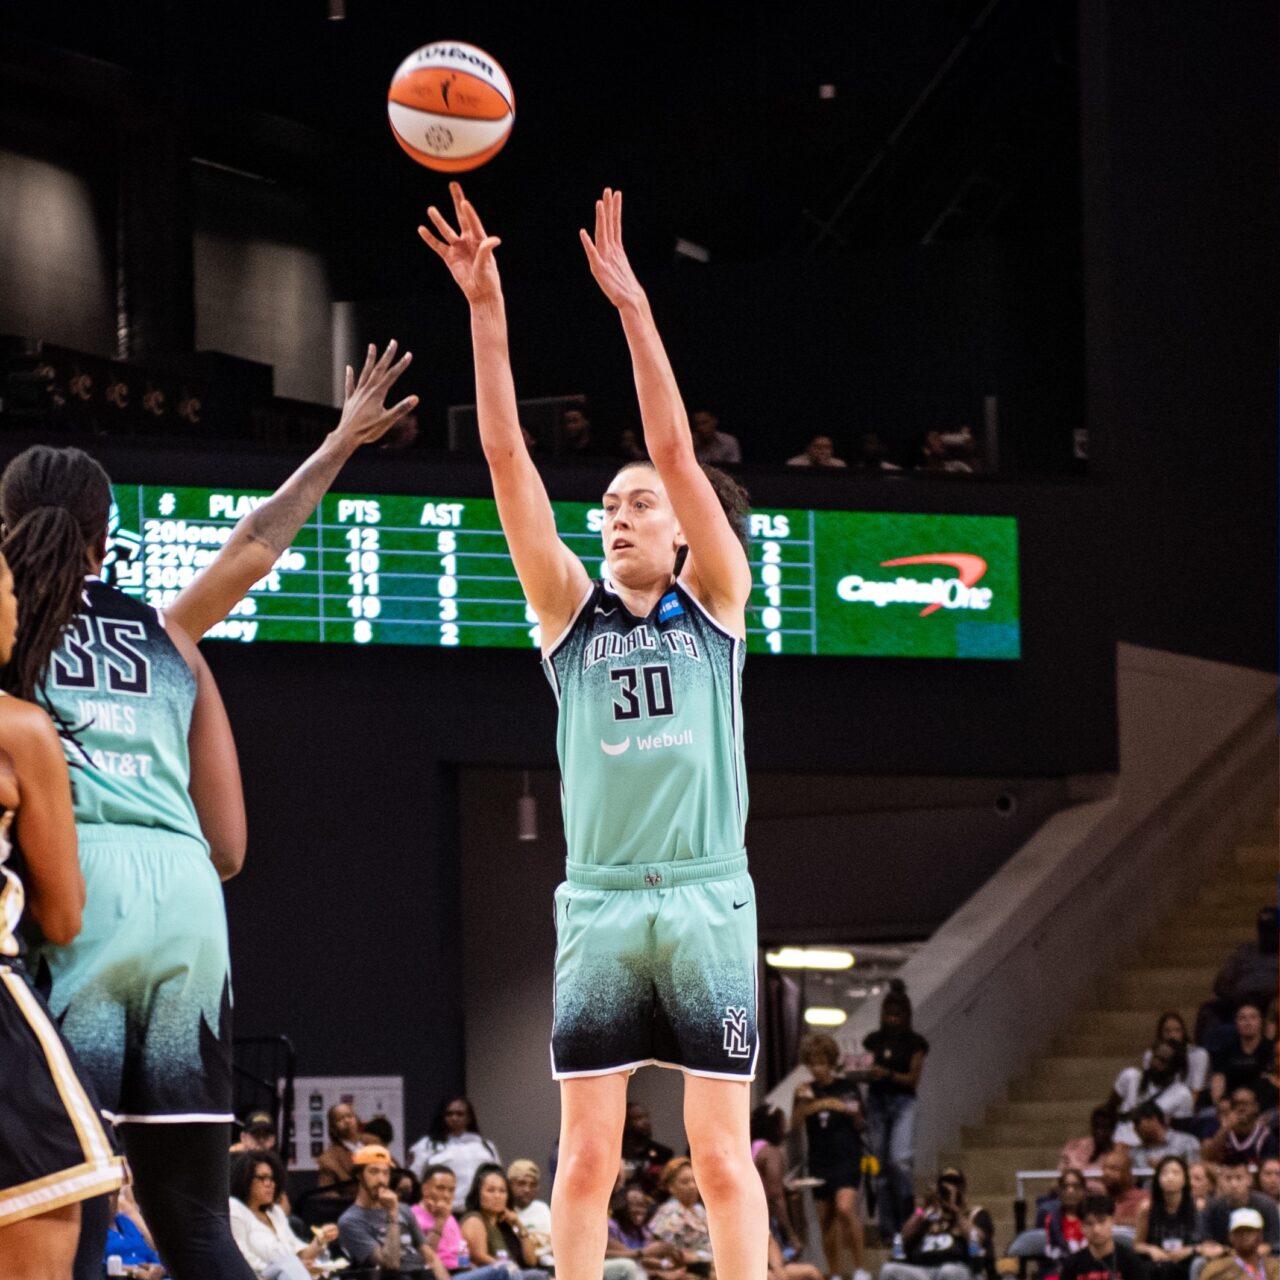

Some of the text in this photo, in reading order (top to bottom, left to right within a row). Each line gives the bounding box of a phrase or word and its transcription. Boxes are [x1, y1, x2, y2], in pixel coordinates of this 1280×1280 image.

[338, 499, 382, 524] PTS
[420, 503, 464, 526] AST
[749, 514, 790, 538] FLS
[345, 527, 380, 550] 12
[762, 541, 781, 563] 2
[345, 550, 380, 573] 10
[440, 553, 457, 575] 1
[347, 572, 380, 595] 11
[764, 584, 781, 607] 1
[347, 595, 382, 618] 19
[438, 598, 458, 621] 3
[50, 613, 153, 696] 35
[439, 622, 460, 645] 2
[766, 630, 782, 653] 1
[583, 625, 701, 673] EQUALTY
[609, 664, 674, 721] 30
[78, 700, 137, 735] JONES
[636, 729, 693, 750] Webull
[90, 749, 152, 777] AT&T
